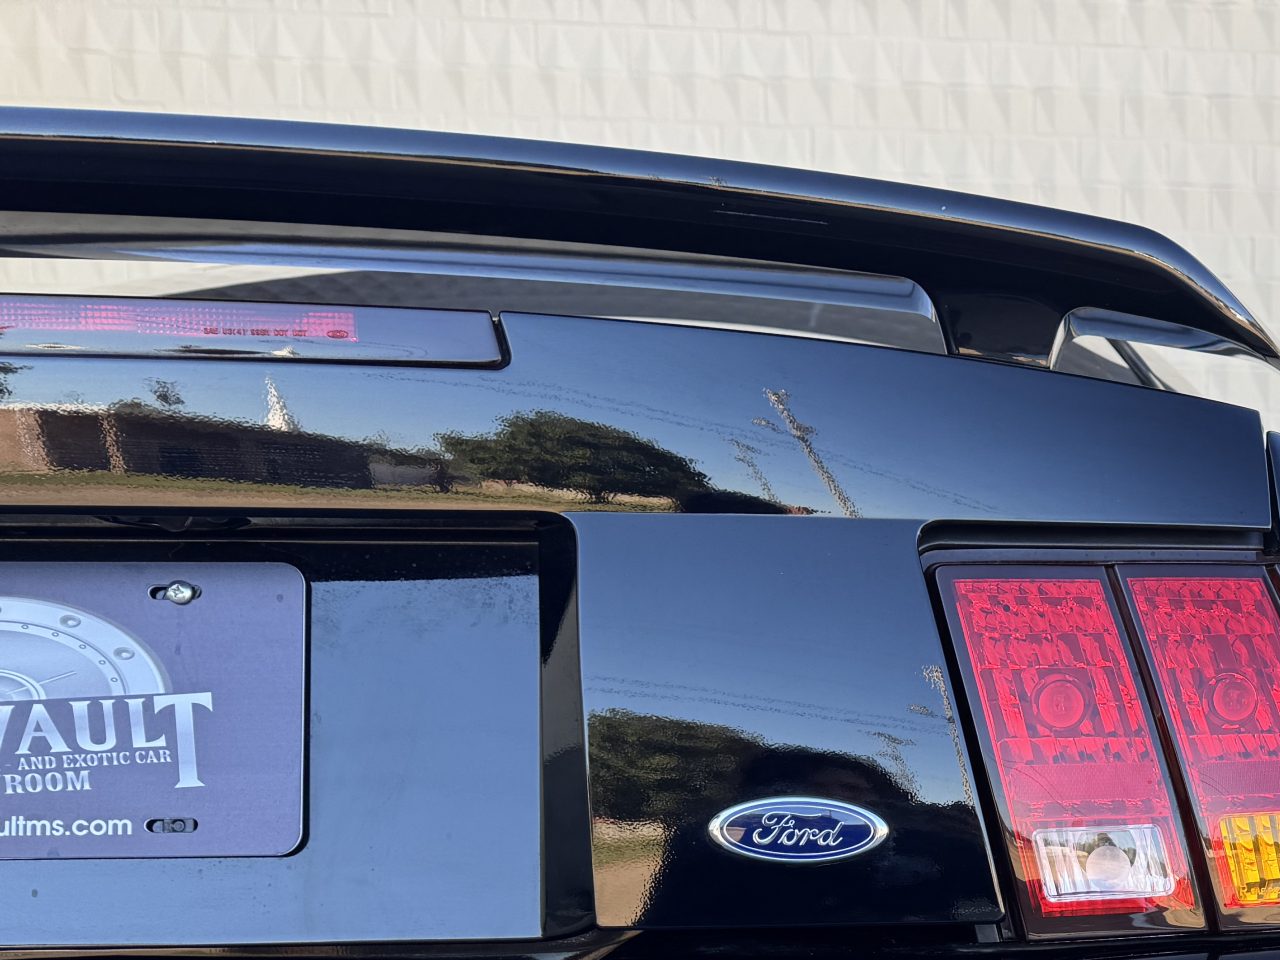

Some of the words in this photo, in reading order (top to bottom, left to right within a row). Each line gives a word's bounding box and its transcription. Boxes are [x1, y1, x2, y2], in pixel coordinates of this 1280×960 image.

[18, 755, 57, 771] AND
[63, 751, 131, 769] EXOTIC
[136, 749, 173, 765] CAR
[0, 770, 92, 795] ROOM
[753, 811, 845, 847] Ford
